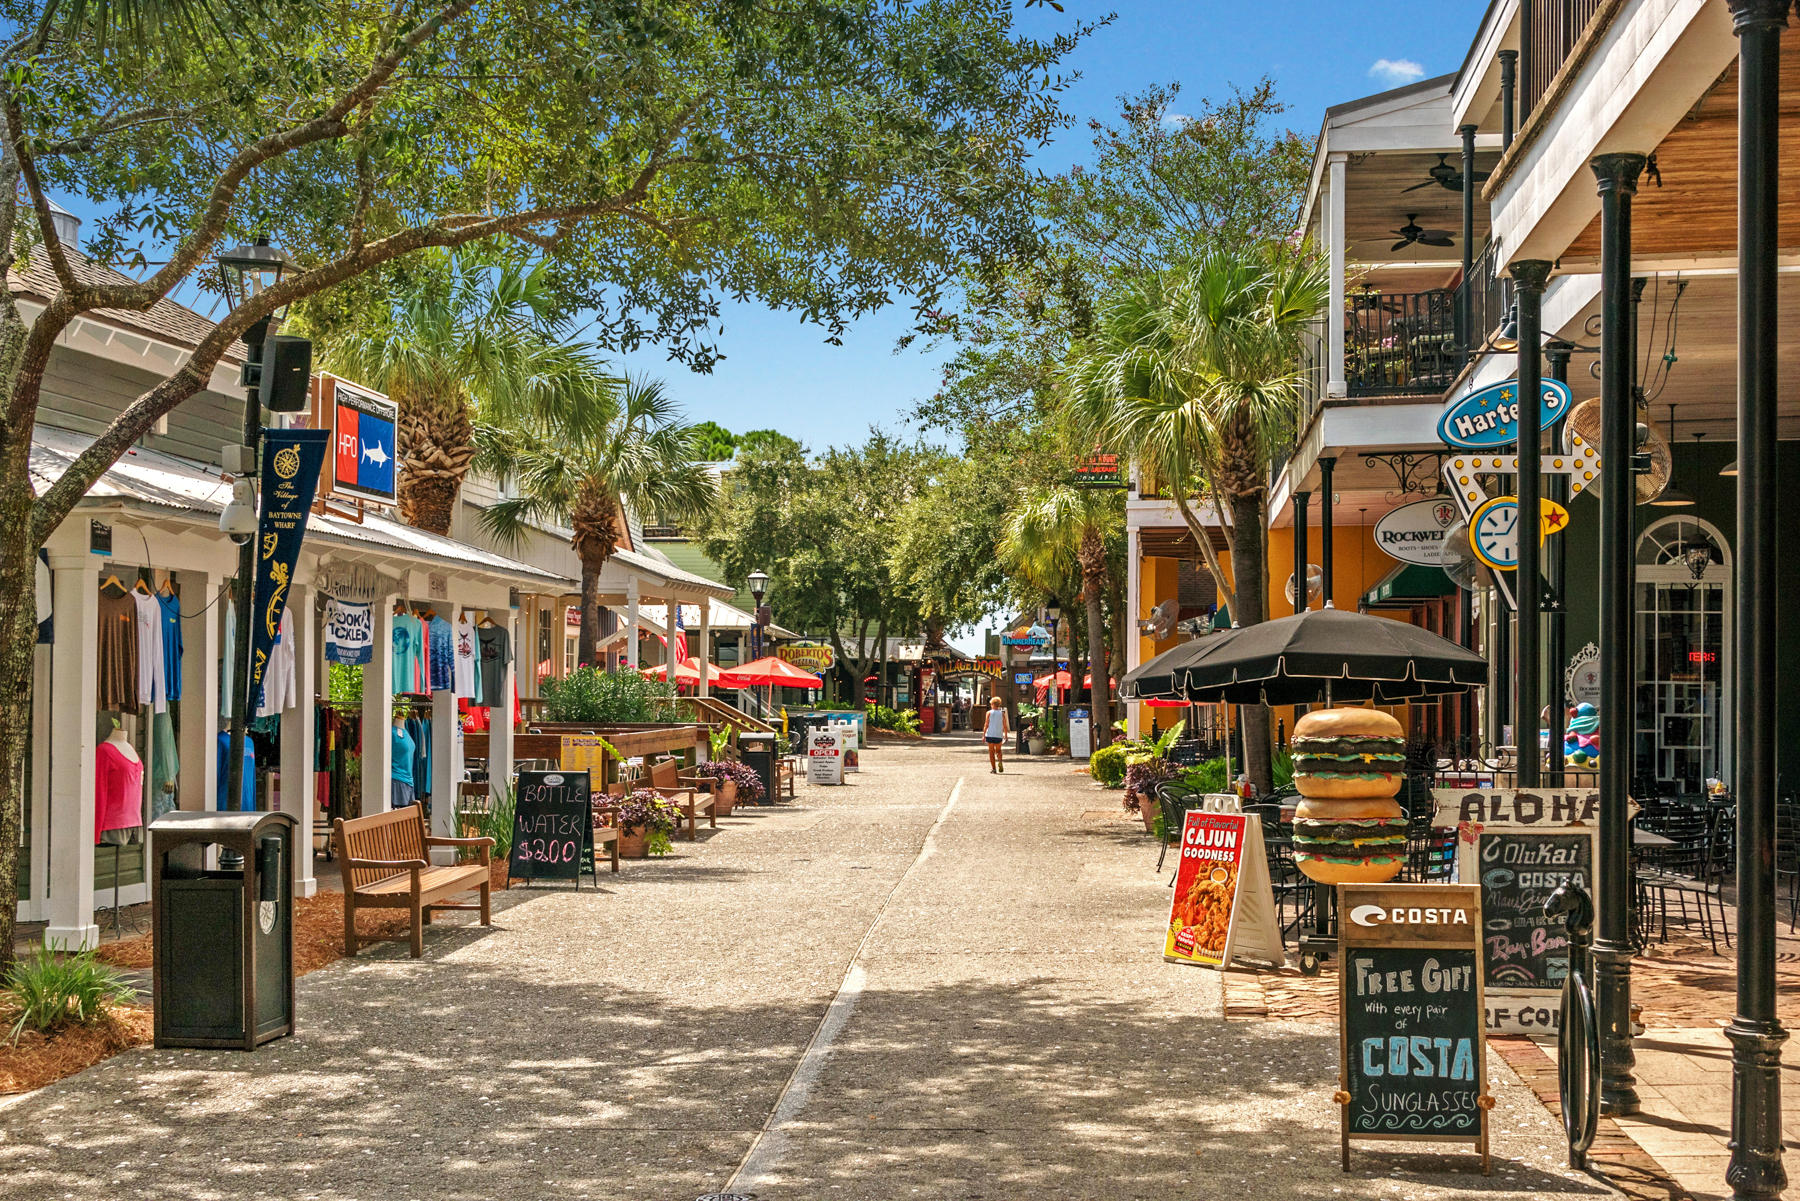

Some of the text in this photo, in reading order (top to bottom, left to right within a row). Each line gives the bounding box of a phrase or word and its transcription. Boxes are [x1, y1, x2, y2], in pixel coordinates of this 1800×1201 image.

[1454, 391, 1559, 438] Hartes
[338, 432, 357, 458] HPO
[278, 481, 294, 490] The
[273, 490, 299, 501] Village
[281, 502, 290, 510] of
[268, 511, 302, 519] BAYTOWNE
[274, 521, 296, 529] WHARF
[973, 659, 1003, 680] DOOR
[522, 783, 585, 804] BOTTLE
[519, 814, 581, 836] WATER
[1188, 816, 1239, 830] Full of Flavorful
[1186, 827, 1237, 849] CAJUN
[1183, 847, 1235, 862] GOODNESS
[1518, 872, 1586, 889] COSTA
[1392, 908, 1468, 925] COSTA
[1513, 915, 1568, 928] OAKLE
[1354, 957, 1472, 996] FREE GIFT
[1394, 1005, 1422, 1023] every
[1362, 1035, 1475, 1082] COSTA
[1361, 1083, 1478, 1113] SUNGLASSES
